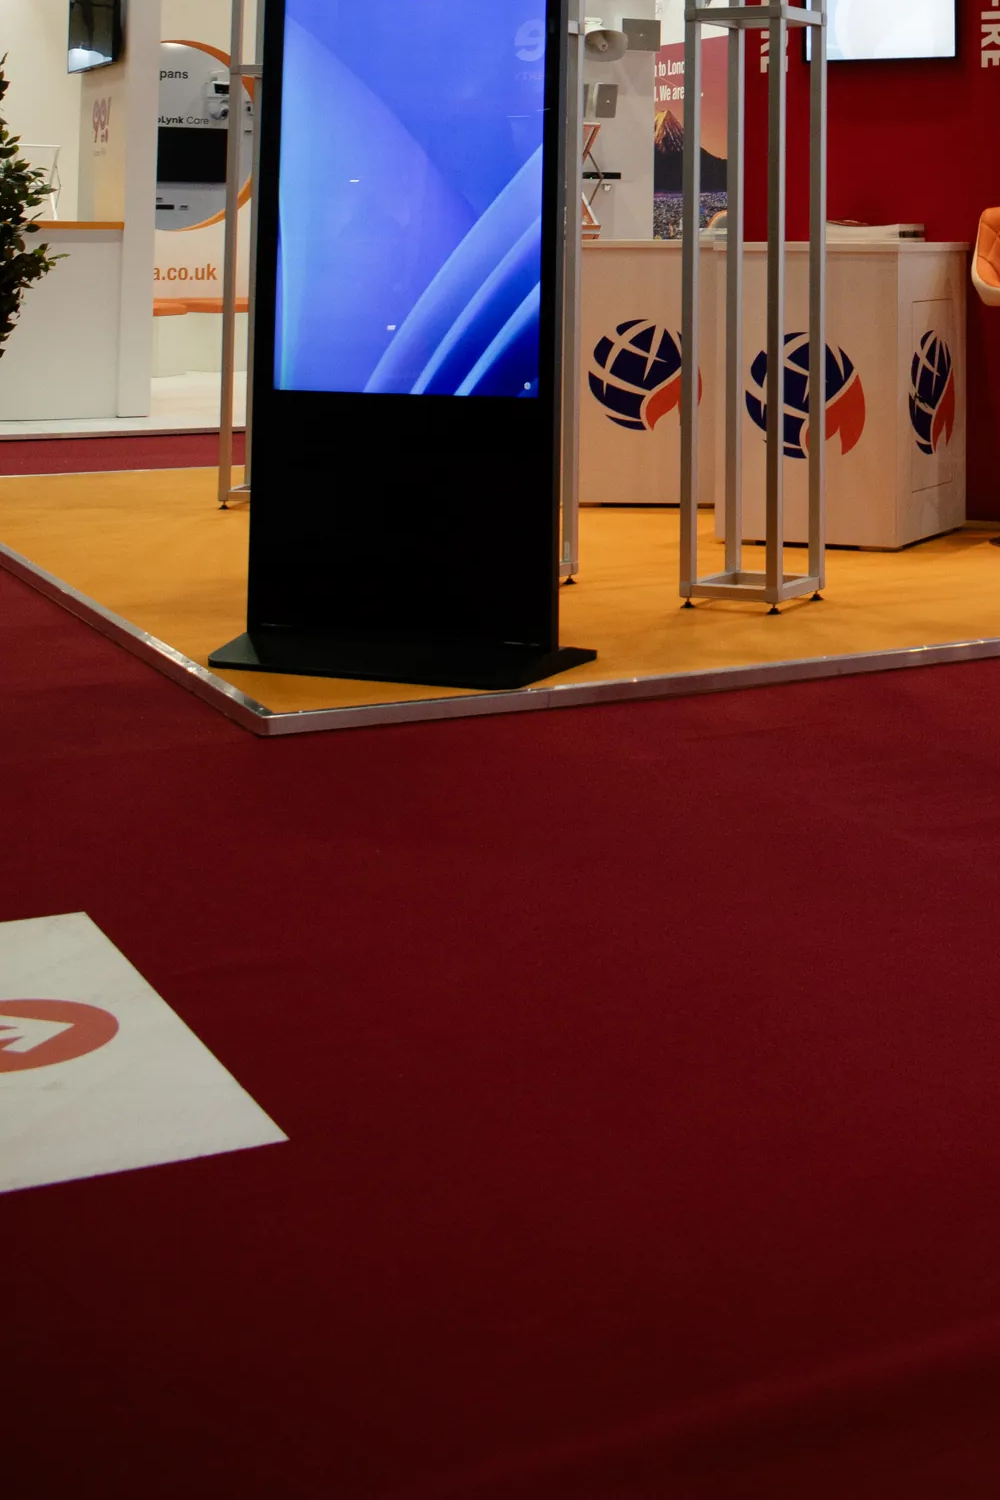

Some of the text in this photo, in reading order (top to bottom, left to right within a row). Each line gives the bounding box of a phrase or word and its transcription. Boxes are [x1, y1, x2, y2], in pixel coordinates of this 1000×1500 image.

[659, 62, 666, 76] to
[660, 84, 671, 101] We
[672, 85, 684, 100] are
[186, 116, 209, 125] Care
